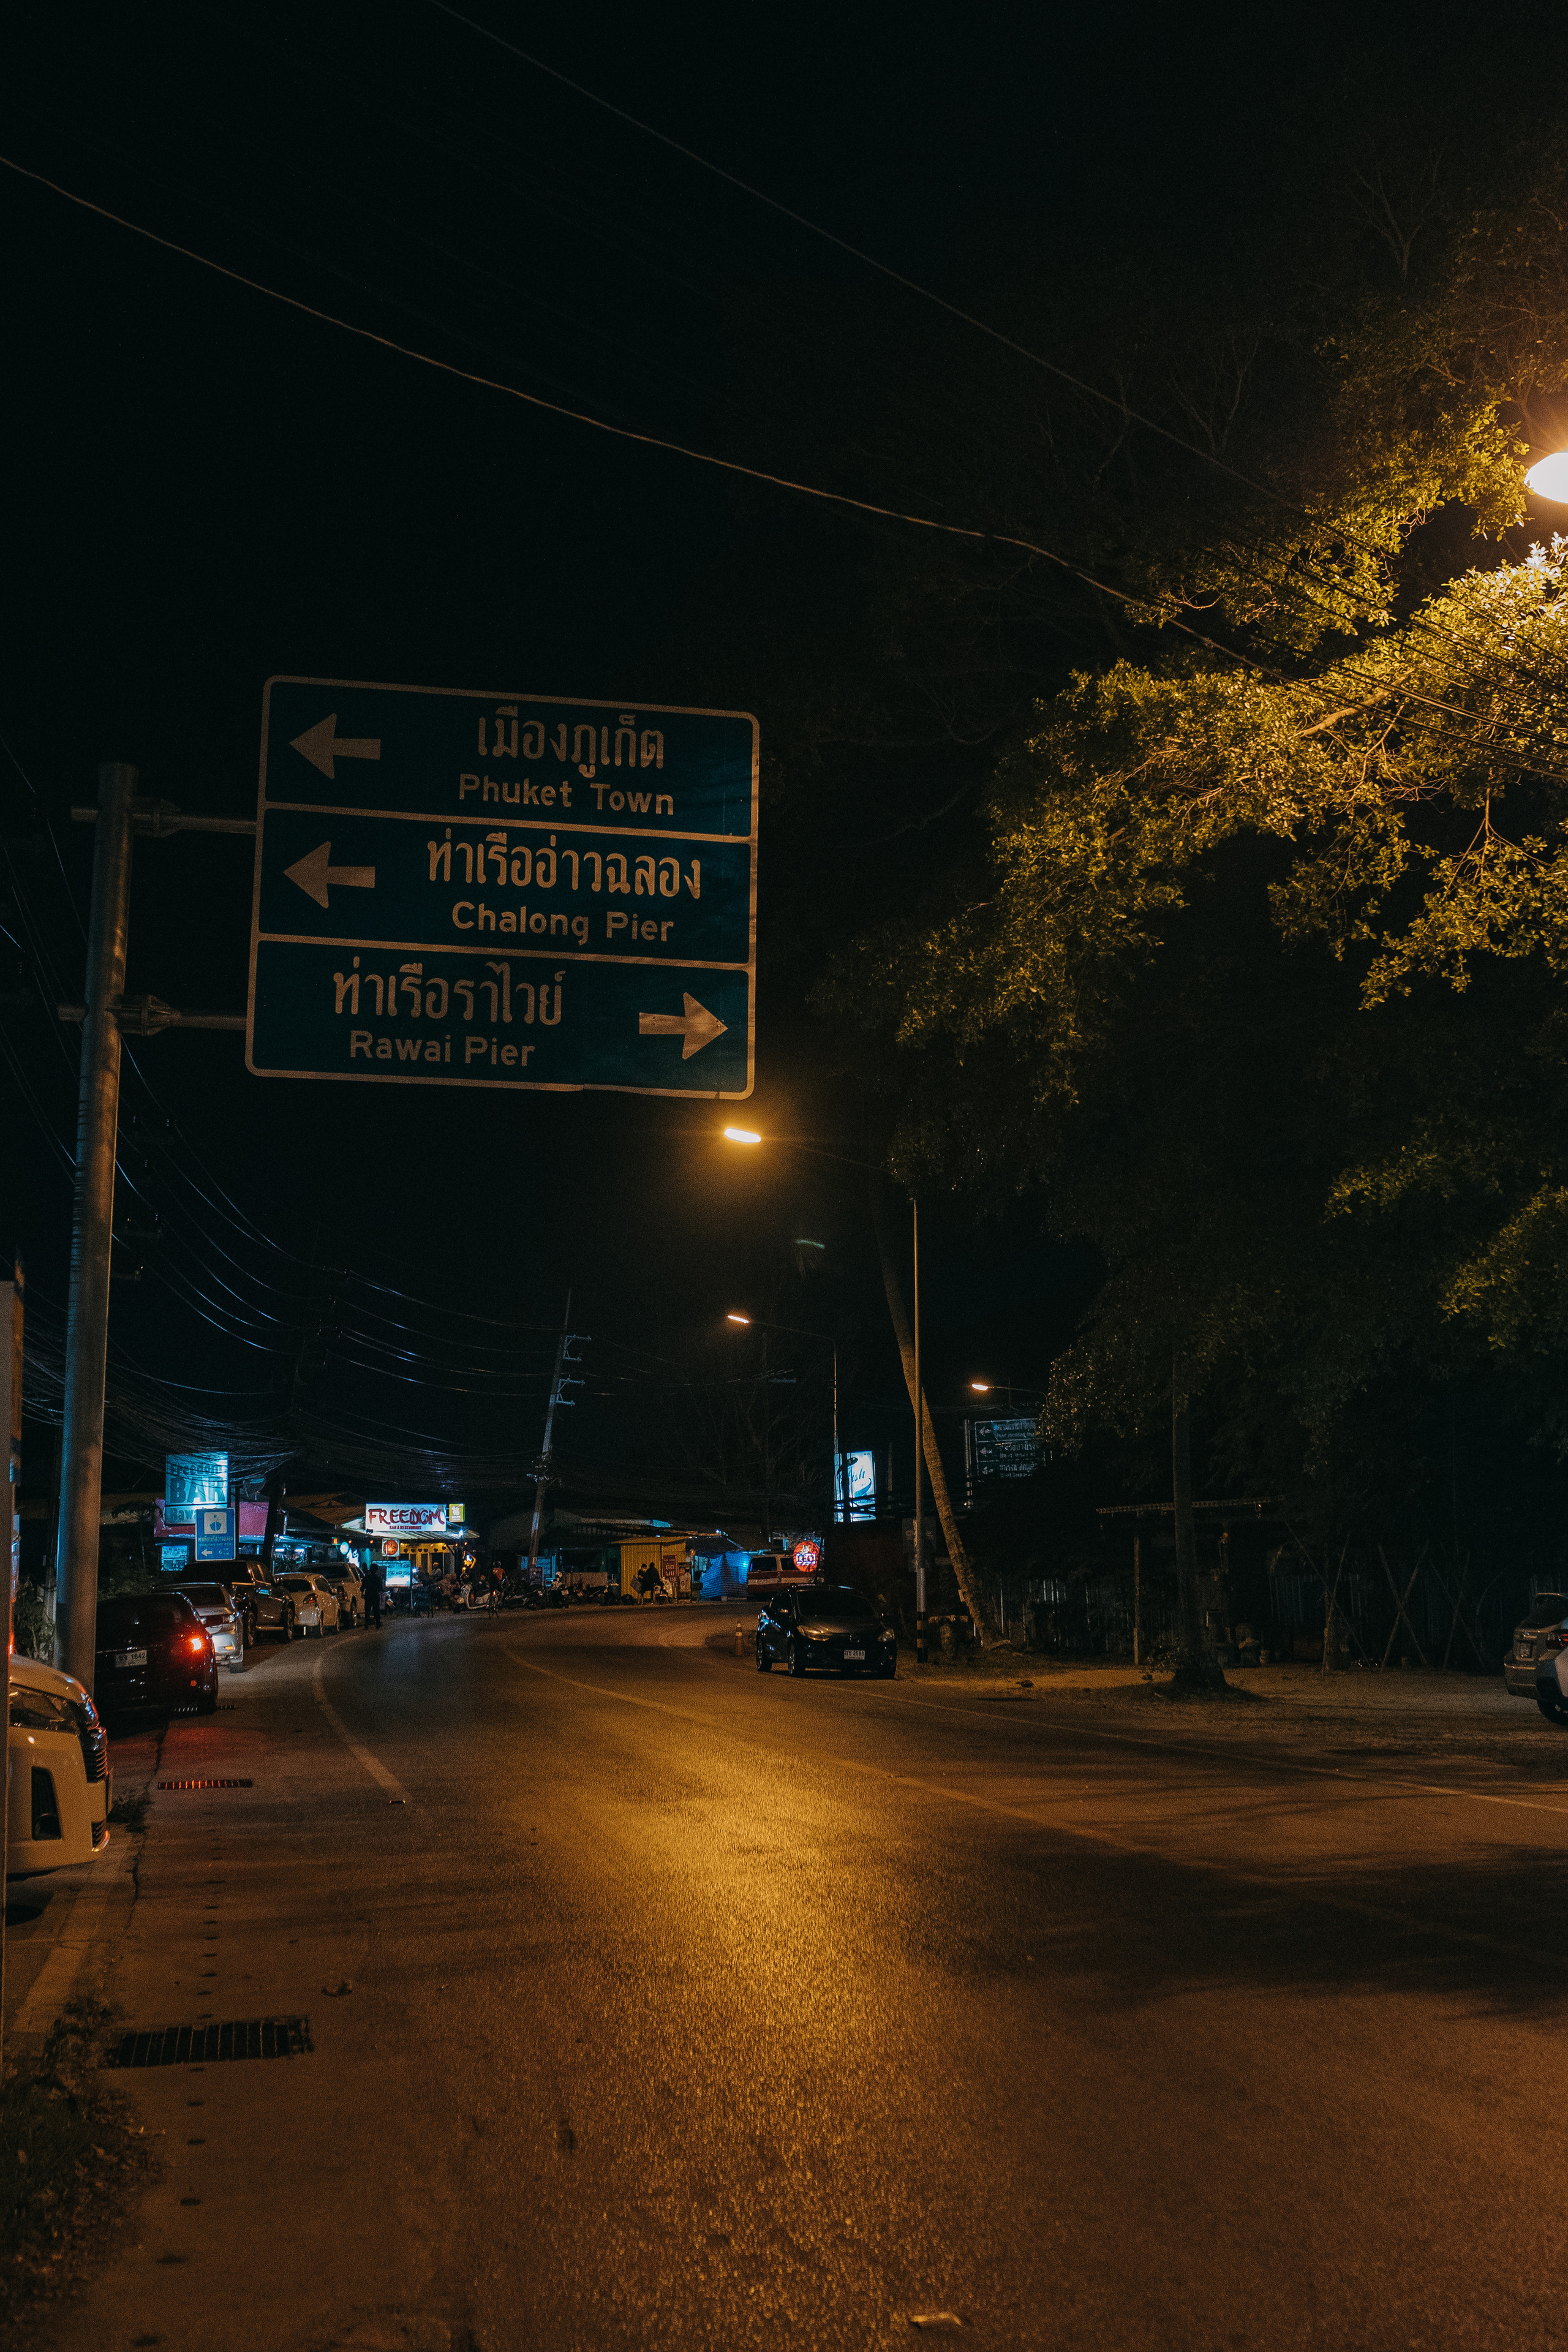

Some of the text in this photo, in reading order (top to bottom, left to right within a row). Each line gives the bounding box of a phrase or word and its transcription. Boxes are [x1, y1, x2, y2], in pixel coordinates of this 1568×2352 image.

[478, 705, 665, 779] เมืองภูเก็ต
[459, 774, 674, 816] Phuket Town
[427, 828, 701, 899] ท่าเรืออ่าวฉลอง
[451, 900, 674, 946] Chalong Pier
[333, 956, 566, 1026] ท่าเรือราไวย์
[350, 1030, 535, 1067] Rawai Pier
[170, 1476, 225, 1503] BAR
[368, 1509, 445, 1525] FREEDOM
